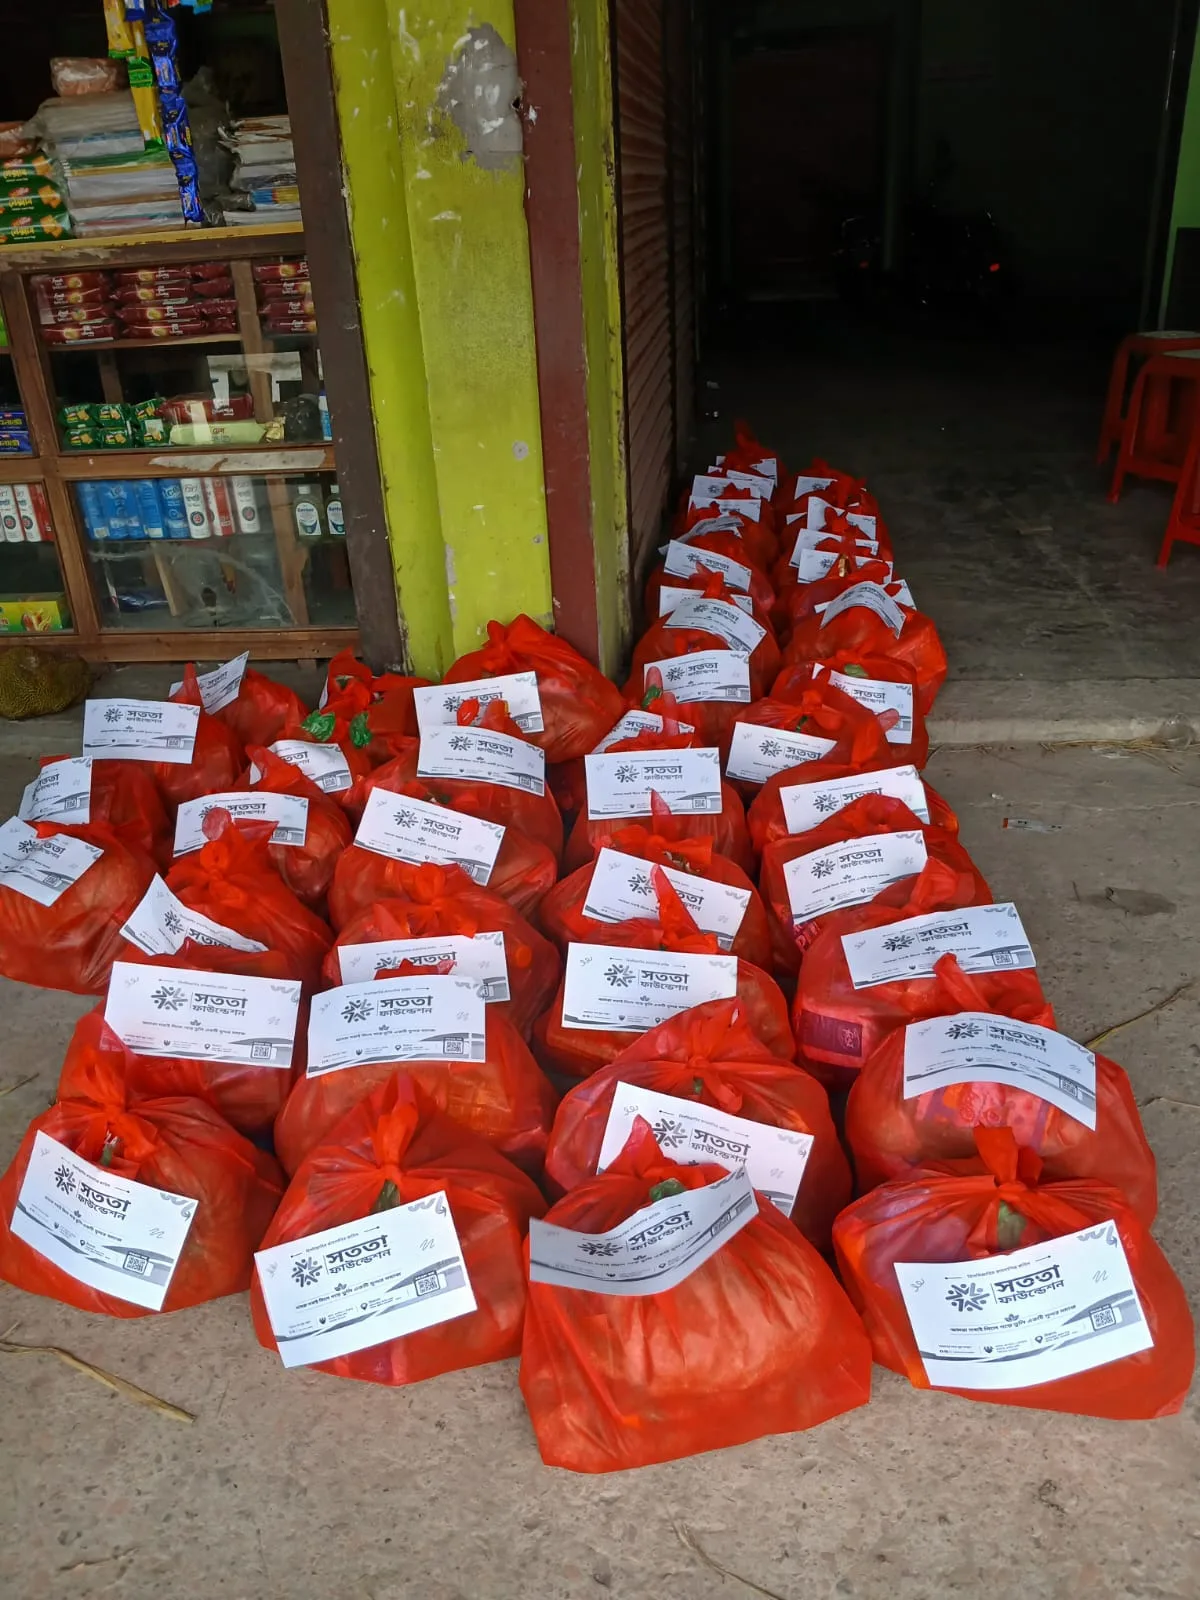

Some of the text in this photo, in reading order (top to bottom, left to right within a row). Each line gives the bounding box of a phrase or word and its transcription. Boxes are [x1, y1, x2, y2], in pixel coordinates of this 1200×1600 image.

[839, 849, 882, 863] সততা
[641, 970, 690, 984] সততা
[194, 992, 248, 1009] সততা
[380, 996, 433, 1008] সততা
[694, 1129, 751, 1156] সততা
[80, 1182, 131, 1212] সততা
[628, 1210, 690, 1244] সততা
[326, 1235, 388, 1263] সততা
[329, 1249, 391, 1273] ফাউন্ডেশন
[994, 1265, 1060, 1292] সততা
[998, 1279, 1065, 1303] ফাউন্ডেশন
